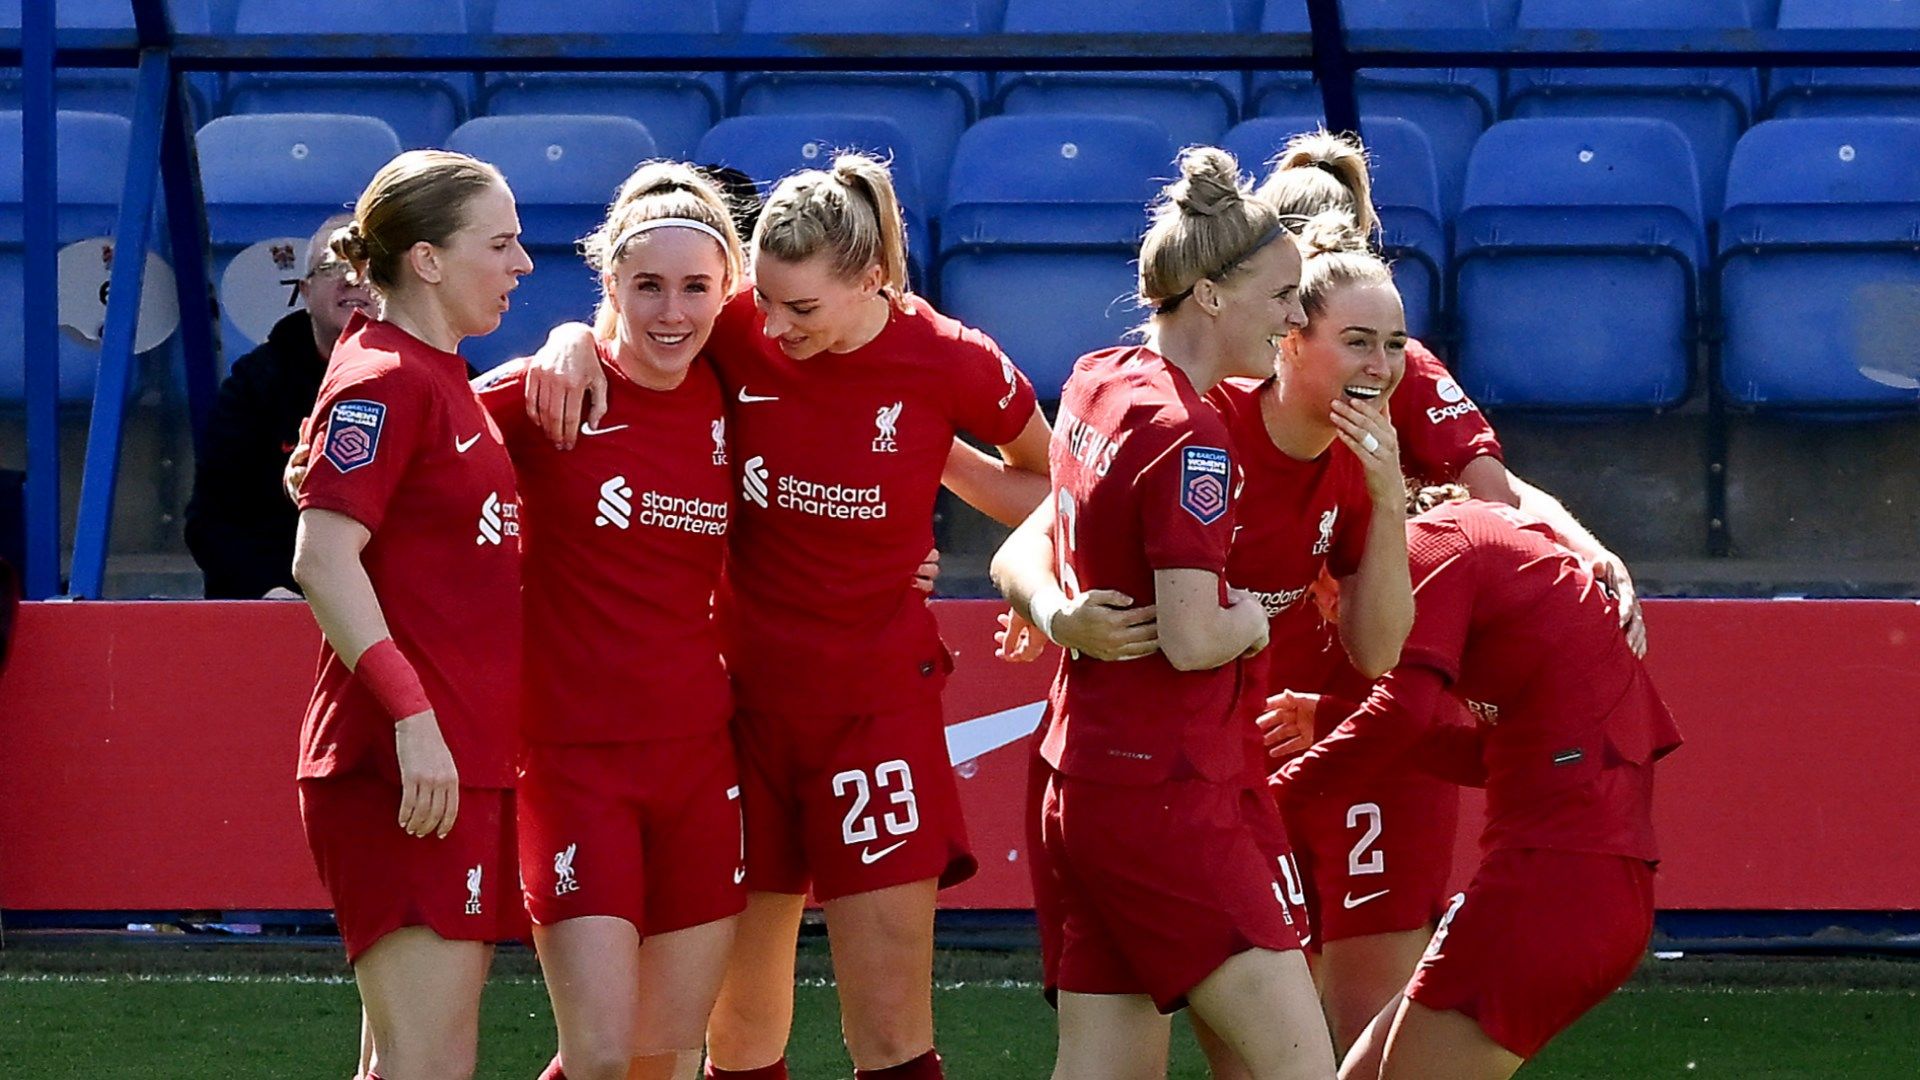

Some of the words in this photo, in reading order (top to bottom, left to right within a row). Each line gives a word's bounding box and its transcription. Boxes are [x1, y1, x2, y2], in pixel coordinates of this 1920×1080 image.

[280, 279, 300, 307] 7
[776, 475, 880, 503] standard
[641, 490, 728, 519] standard
[777, 493, 887, 519] chartered
[640, 508, 728, 535] chartered
[832, 759, 919, 845] 23
[1346, 802, 1384, 876] 2
